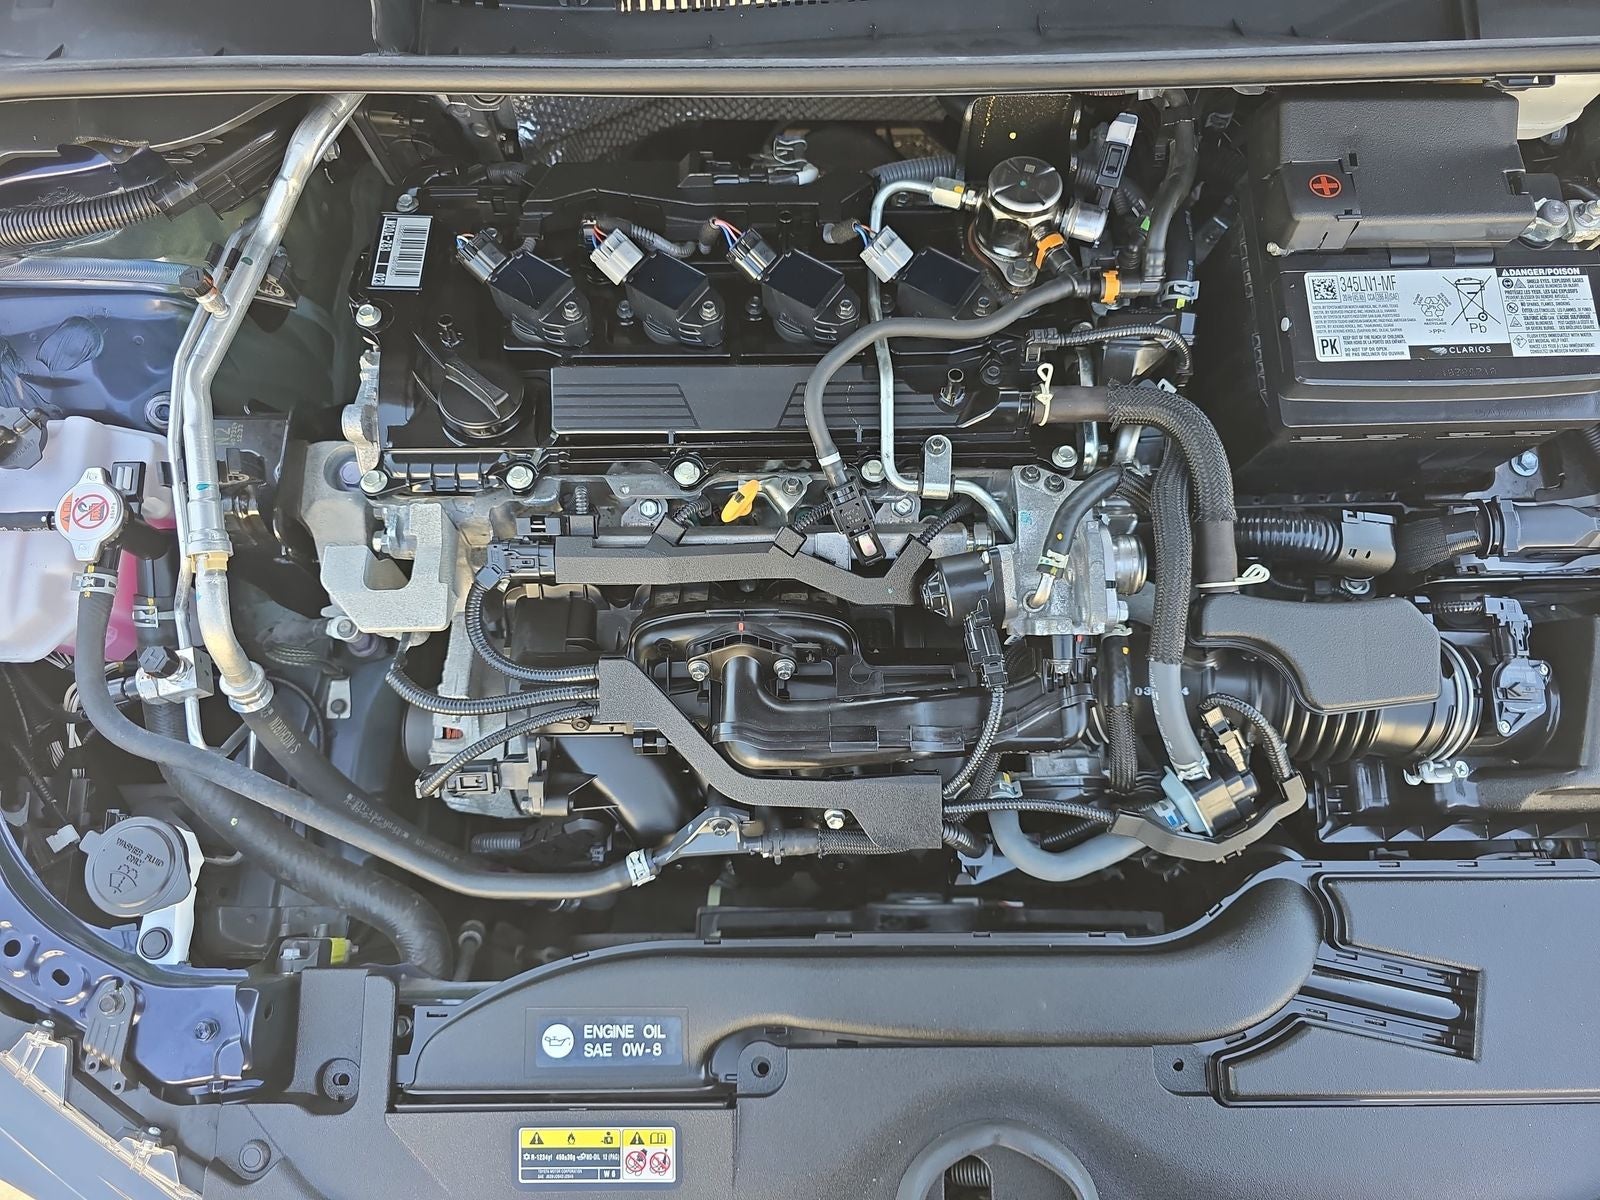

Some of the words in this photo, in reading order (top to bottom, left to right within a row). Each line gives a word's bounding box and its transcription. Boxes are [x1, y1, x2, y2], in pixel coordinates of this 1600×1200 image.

[1509, 268, 1580, 276] DANGER/POISON
[1340, 275, 1396, 292] 345LN1-MF
[1470, 323, 1487, 333] Pb
[1321, 339, 1339, 355] PK
[116, 838, 143, 856] WASHER
[145, 854, 164, 867] FLUID
[126, 854, 142, 867] ONLY
[584, 1024, 634, 1038] ENGINE
[643, 1024, 666, 1038] OIL
[584, 1043, 612, 1057] SAE
[623, 1043, 662, 1056] 0W-8
